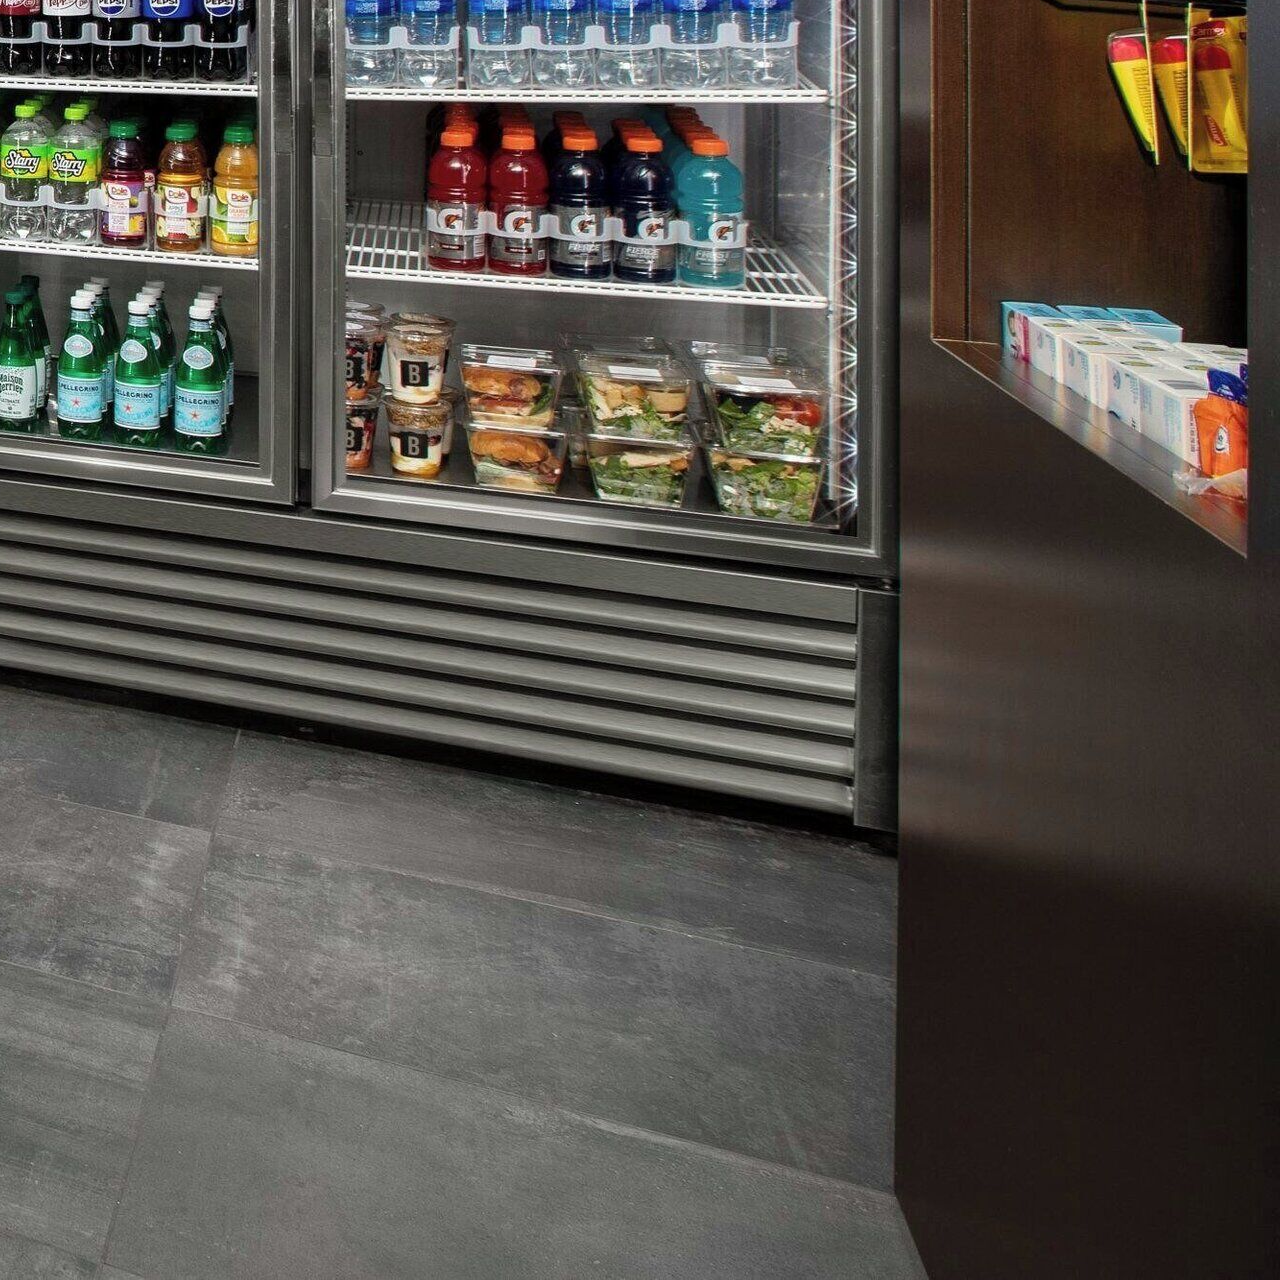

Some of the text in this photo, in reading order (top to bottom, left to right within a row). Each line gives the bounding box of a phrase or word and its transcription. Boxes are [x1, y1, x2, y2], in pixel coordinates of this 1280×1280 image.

[6, 151, 40, 172] Starry
[52, 153, 86, 177] Starry
[111, 187, 128, 195] Dole
[568, 243, 600, 254] FIERCE
[626, 246, 660, 257] FIERCE
[408, 365, 420, 385] B
[407, 436, 420, 456] B
